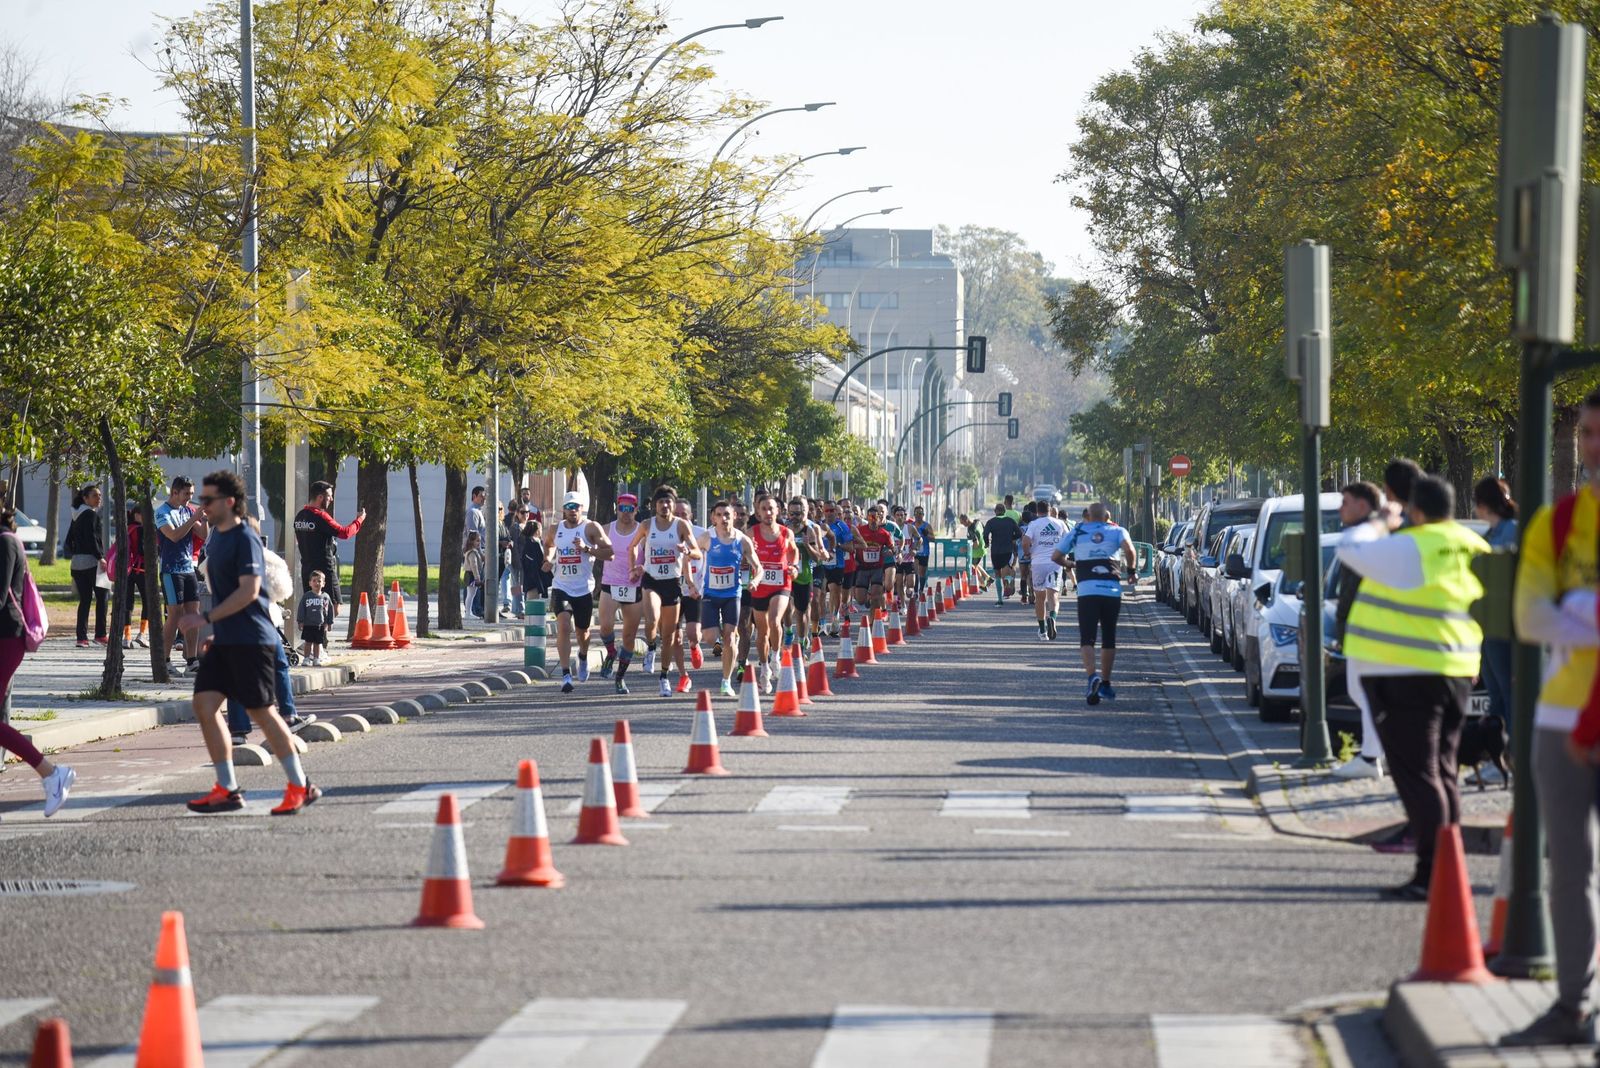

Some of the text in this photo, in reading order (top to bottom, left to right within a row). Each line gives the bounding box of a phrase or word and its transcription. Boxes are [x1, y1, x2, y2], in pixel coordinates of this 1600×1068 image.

[561, 565, 578, 575] 216
[658, 564, 669, 575] 48
[715, 575, 730, 585] 111
[765, 570, 777, 581] 88
[618, 587, 629, 597] 52
